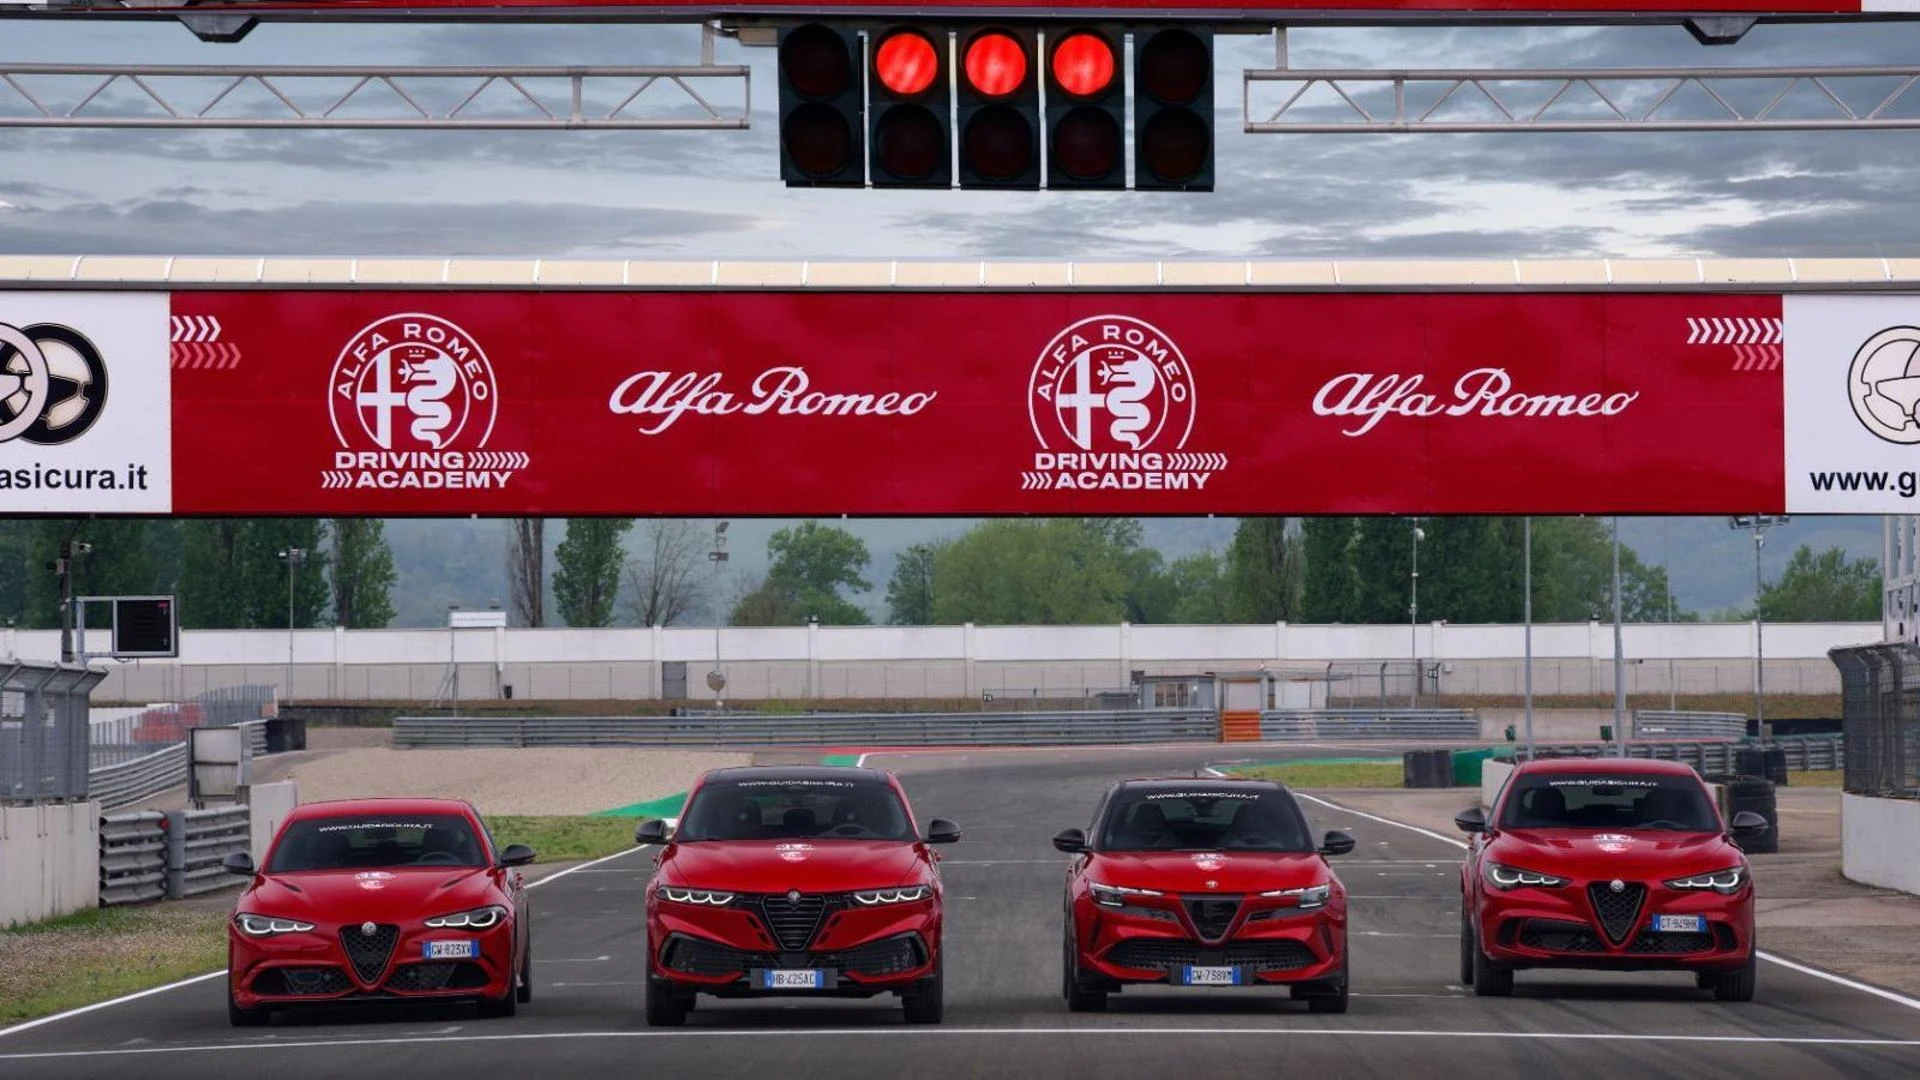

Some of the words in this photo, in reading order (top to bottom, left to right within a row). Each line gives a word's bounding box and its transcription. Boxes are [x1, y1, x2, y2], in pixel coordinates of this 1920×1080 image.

[337, 333, 390, 400] ALFA
[403, 323, 488, 401] ROMEO
[1037, 334, 1089, 401] ALFA
[1103, 324, 1187, 403] ROMEO
[608, 371, 744, 435] Alfa
[743, 366, 938, 415] Romeo
[1312, 372, 1445, 437] Alfa
[1446, 367, 1640, 417] Romeo
[335, 451, 465, 469] DRIVING
[1034, 452, 1163, 470] DRIVING
[355, 471, 513, 488] ACADEMY
[1054, 472, 1211, 489] ACADEMY
[1809, 471, 1920, 498] www.g
